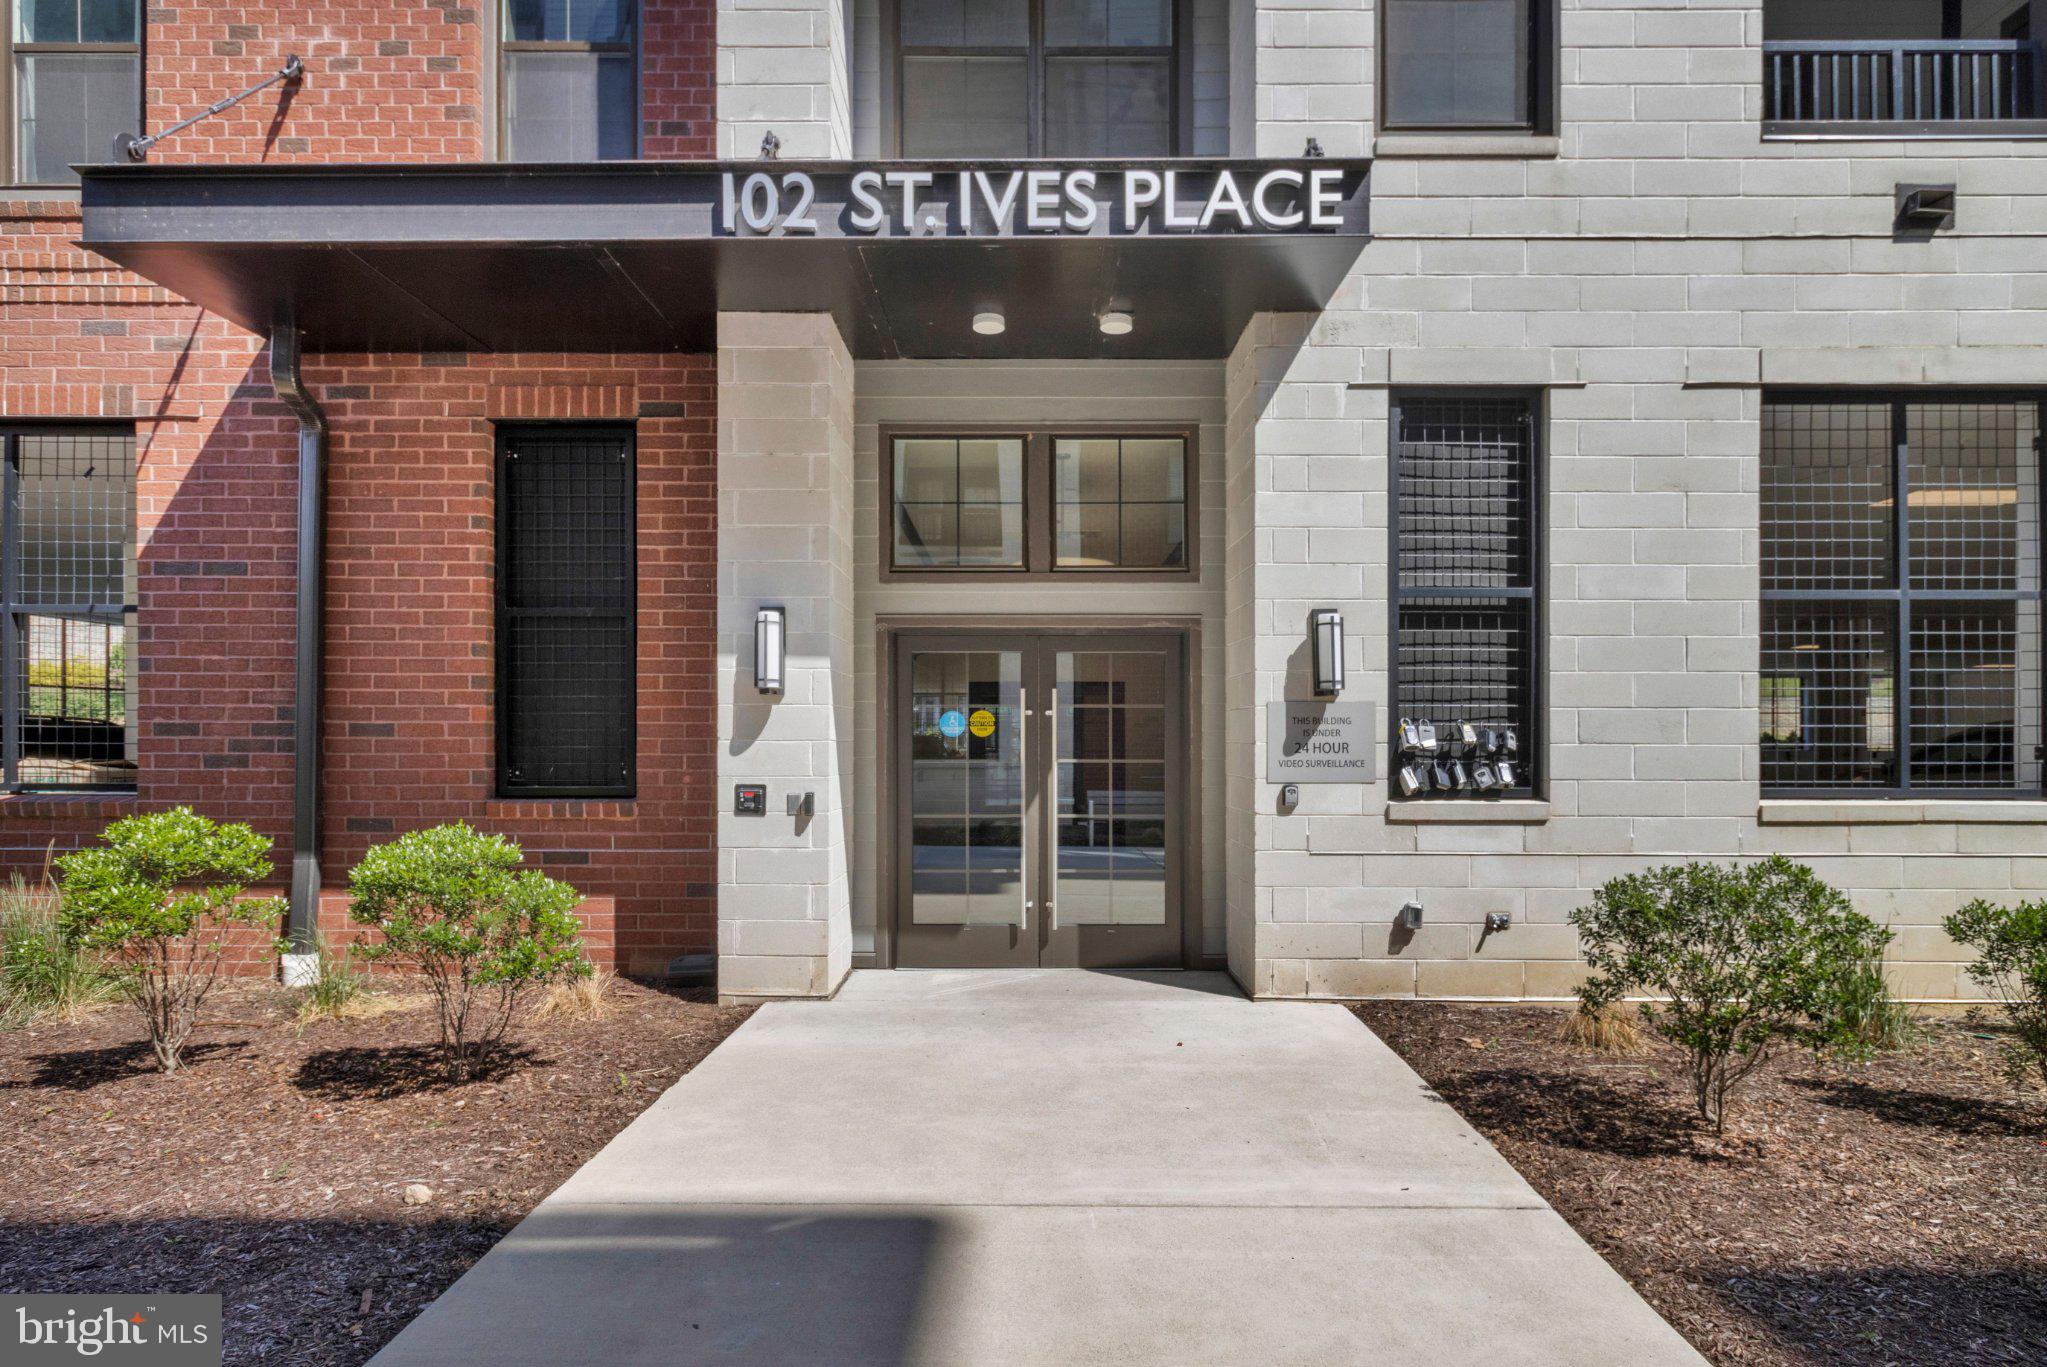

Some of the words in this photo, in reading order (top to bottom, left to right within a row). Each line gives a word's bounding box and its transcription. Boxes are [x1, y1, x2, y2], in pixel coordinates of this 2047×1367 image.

[722, 171, 818, 232] 102
[851, 170, 936, 231] ST.
[960, 170, 1097, 231] IVES
[1124, 169, 1344, 231] PLACE
[1292, 716, 1311, 725] THIS
[1312, 716, 1352, 725] BUILDING
[1302, 728, 1311, 737] IS
[1312, 728, 1341, 737] UNDER
[1294, 742, 1309, 754] 24
[1313, 742, 1350, 754] HOUR
[1278, 759, 1304, 768] VIDEO
[1305, 759, 1366, 768] SURVEILLANCE
